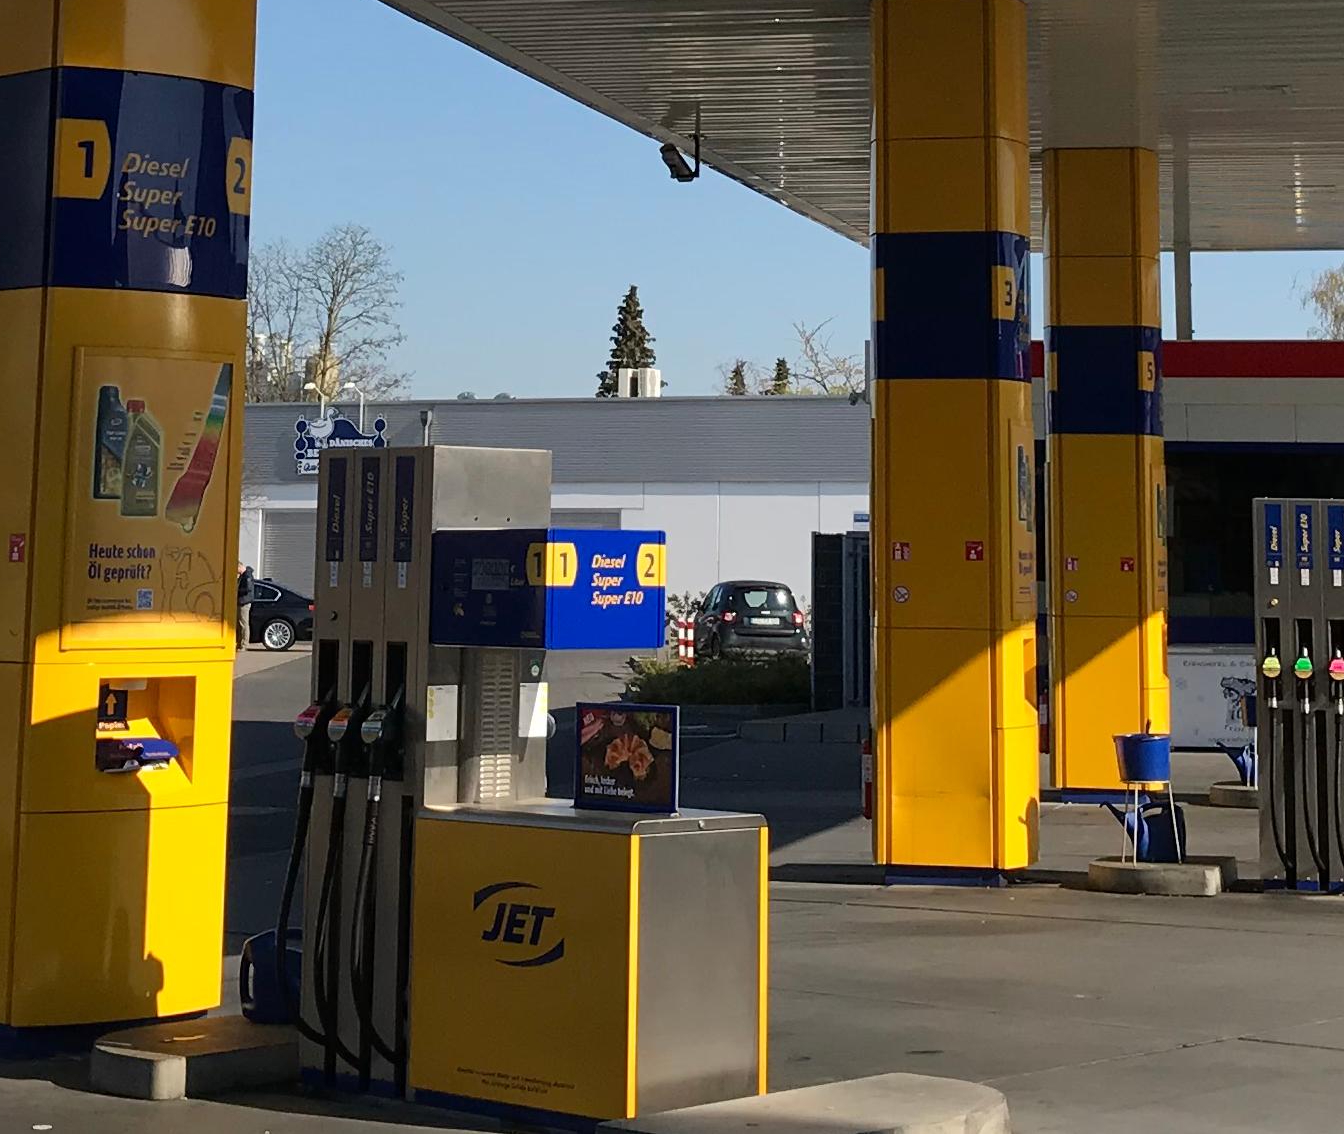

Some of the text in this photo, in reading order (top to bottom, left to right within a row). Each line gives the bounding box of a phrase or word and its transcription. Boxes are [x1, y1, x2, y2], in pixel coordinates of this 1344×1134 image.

[78, 140, 95, 178] 1
[121, 152, 190, 179] Diesel
[232, 157, 246, 195] 2
[119, 180, 184, 210] Super
[118, 209, 217, 239] Super E10
[1004, 280, 1013, 306] 3
[1146, 362, 1153, 380] 5
[329, 437, 374, 448] DÄNISCHES
[332, 494, 341, 533] Diesel
[365, 471, 376, 534] Super E10
[400, 498, 413, 534] Super
[88, 543, 156, 559] Heute schon
[1269, 525, 1278, 551] Diesel
[1300, 529, 1310, 552] Super
[1332, 529, 1342, 553] Super
[88, 561, 152, 583] Öl geprüft?
[533, 552, 542, 578] 1
[560, 552, 568, 578] 1
[591, 554, 626, 569] Diesel
[643, 552, 655, 578] 2
[591, 572, 624, 591] Super
[591, 590, 644, 609] Super E10
[481, 902, 555, 946] JET
